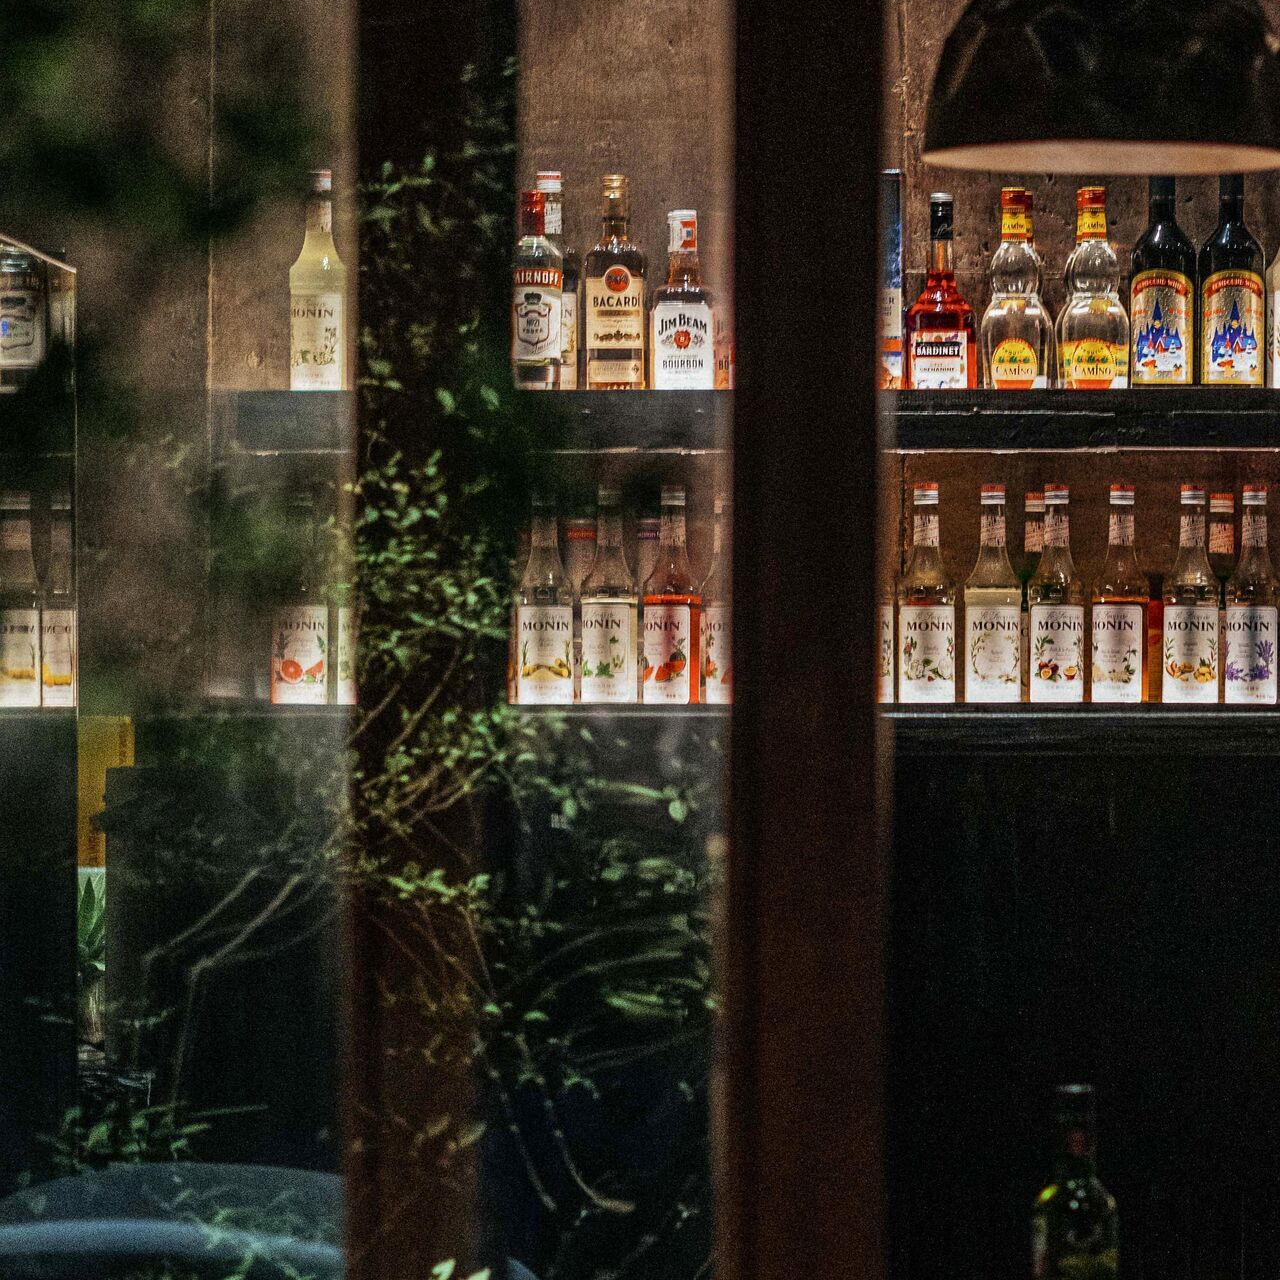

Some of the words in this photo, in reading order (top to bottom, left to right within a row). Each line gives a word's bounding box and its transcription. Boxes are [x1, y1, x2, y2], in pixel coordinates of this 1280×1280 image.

[658, 317, 678, 336] JIM
[678, 313, 707, 336] BEAM
[916, 346, 960, 357] BARDINET
[662, 359, 704, 369] BOURBON
[522, 620, 569, 631] MONIN
[906, 620, 953, 632] MONIN
[972, 620, 1020, 632] MONIN
[1037, 620, 1083, 632] MONIN
[1167, 620, 1216, 632] MONIN
